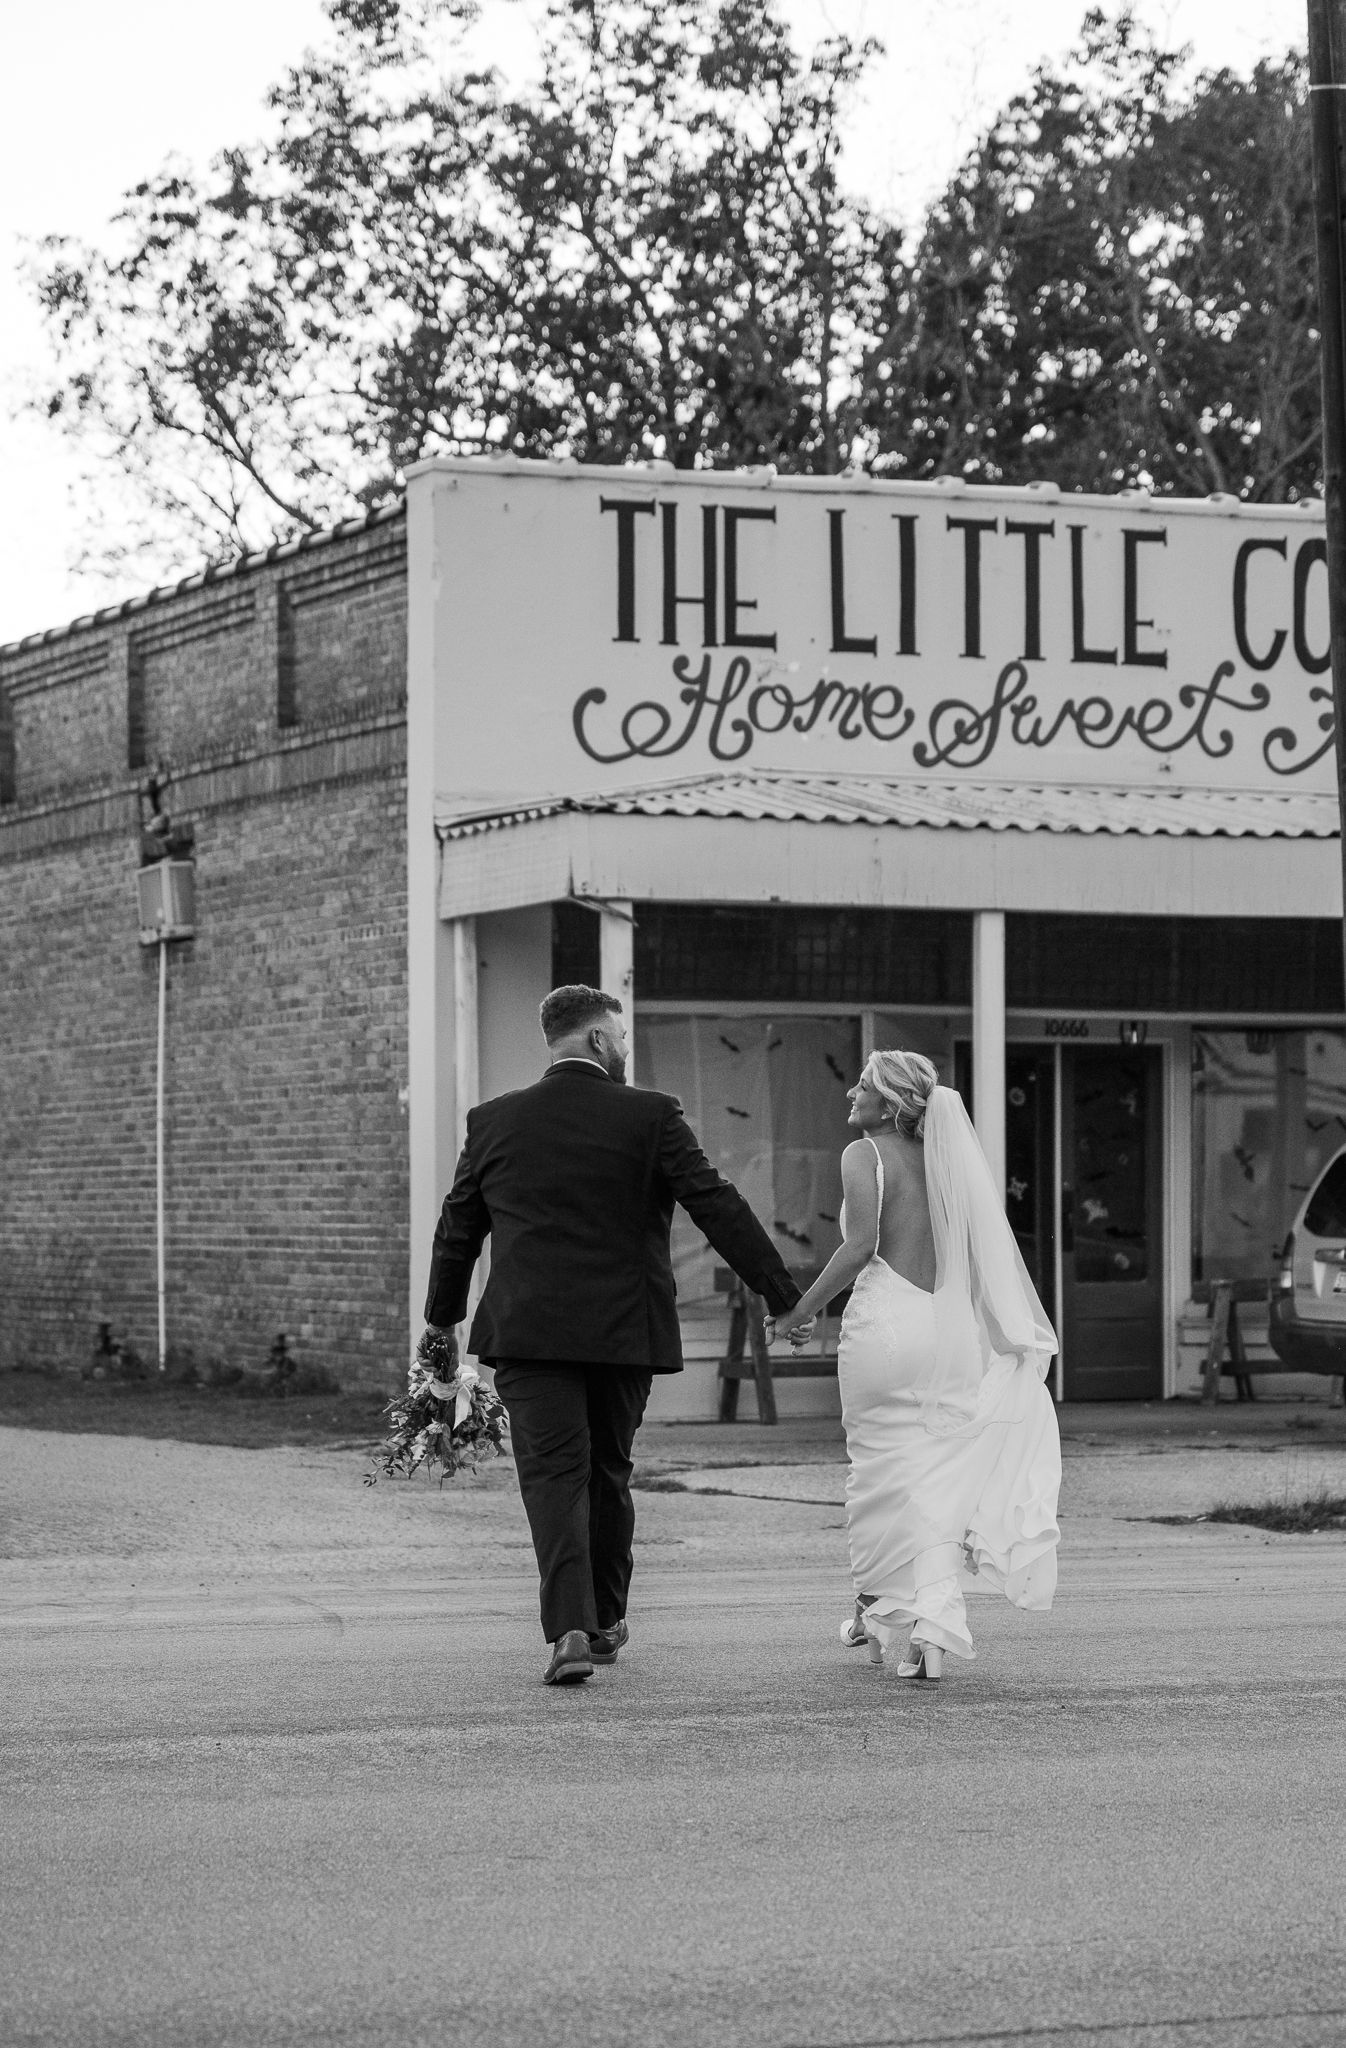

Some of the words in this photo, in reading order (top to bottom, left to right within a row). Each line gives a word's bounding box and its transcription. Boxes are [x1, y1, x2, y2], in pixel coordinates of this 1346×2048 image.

[600, 495, 777, 652] THE
[826, 508, 1168, 669] LITTLE
[573, 653, 915, 764] Home
[913, 660, 1271, 768] Sweet
[1045, 1019, 1089, 1036] 10666
